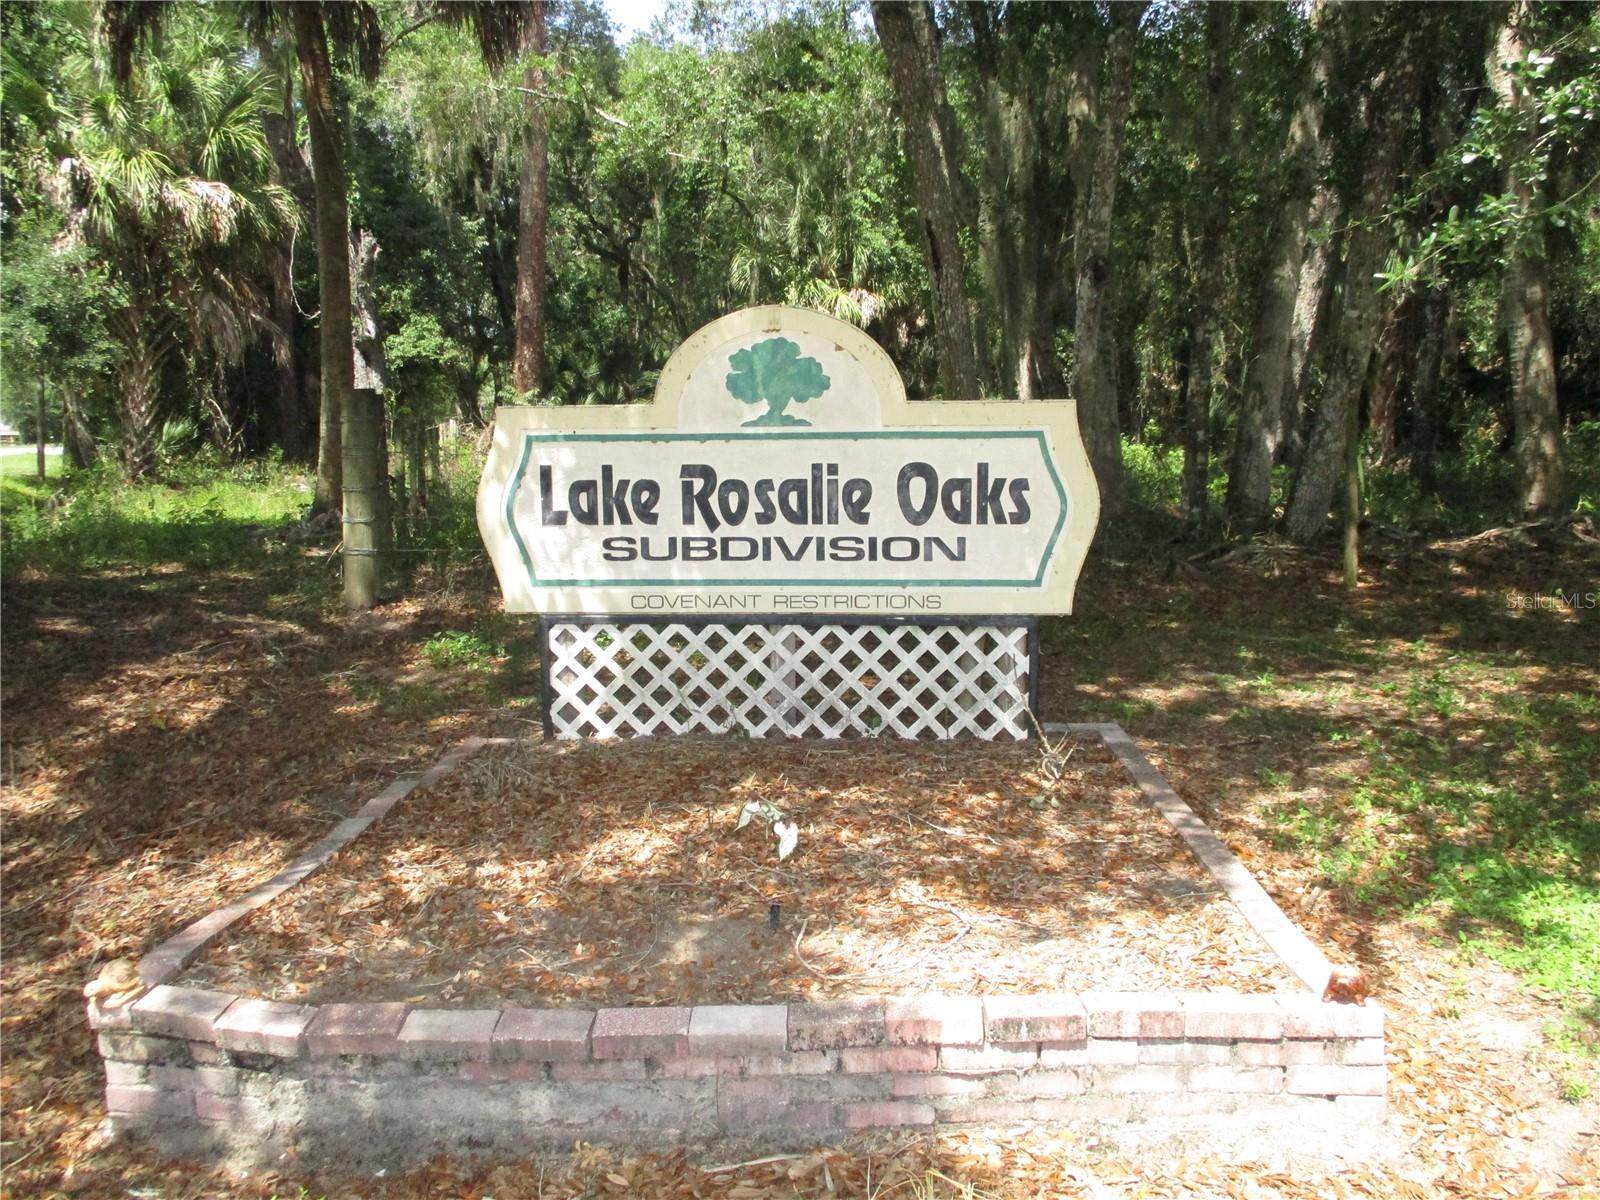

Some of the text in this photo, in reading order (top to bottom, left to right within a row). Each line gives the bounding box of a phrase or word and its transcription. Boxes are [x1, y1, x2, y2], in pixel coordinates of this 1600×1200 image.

[540, 461, 1031, 533] Lake Rosalie Oaks
[601, 535, 966, 562] SUBDIVISION
[630, 594, 942, 610] COVENANT RESTRICTIONS
